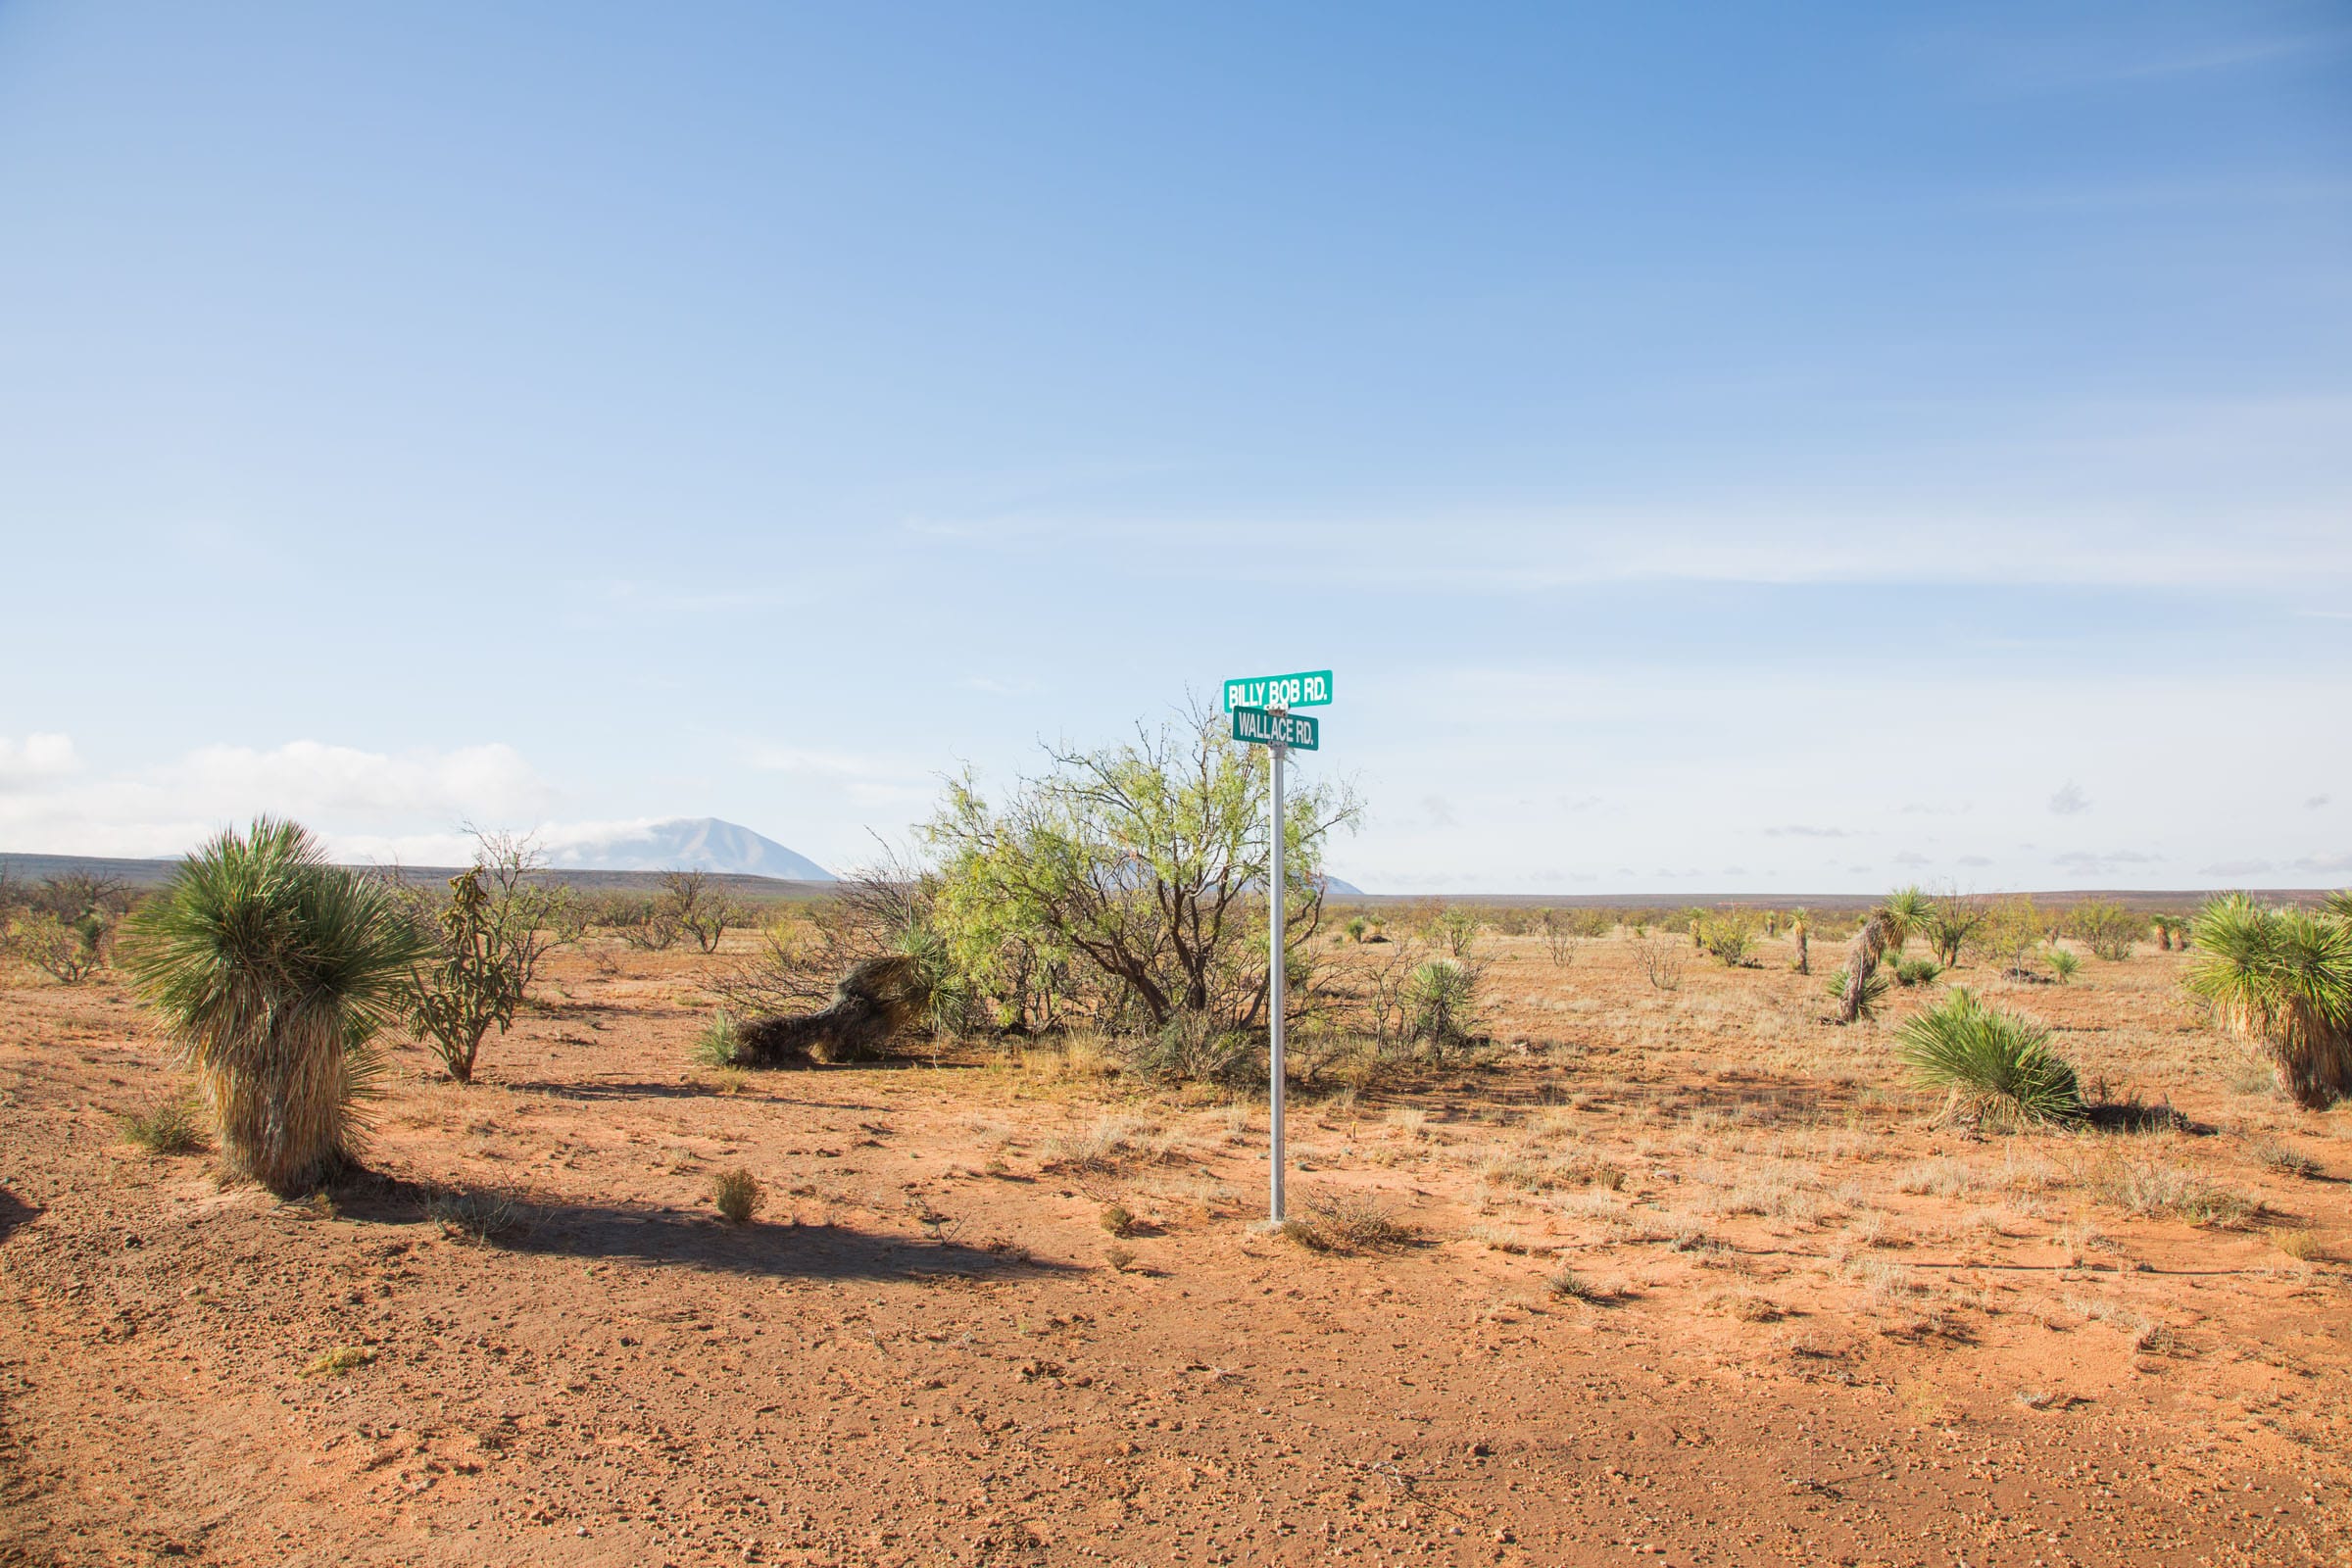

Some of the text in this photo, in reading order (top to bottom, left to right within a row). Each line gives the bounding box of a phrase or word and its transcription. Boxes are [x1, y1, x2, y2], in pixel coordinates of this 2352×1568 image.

[1229, 676, 1327, 709] BILLY BOB RD.
[1239, 711, 1313, 745] WALLACE RD.
